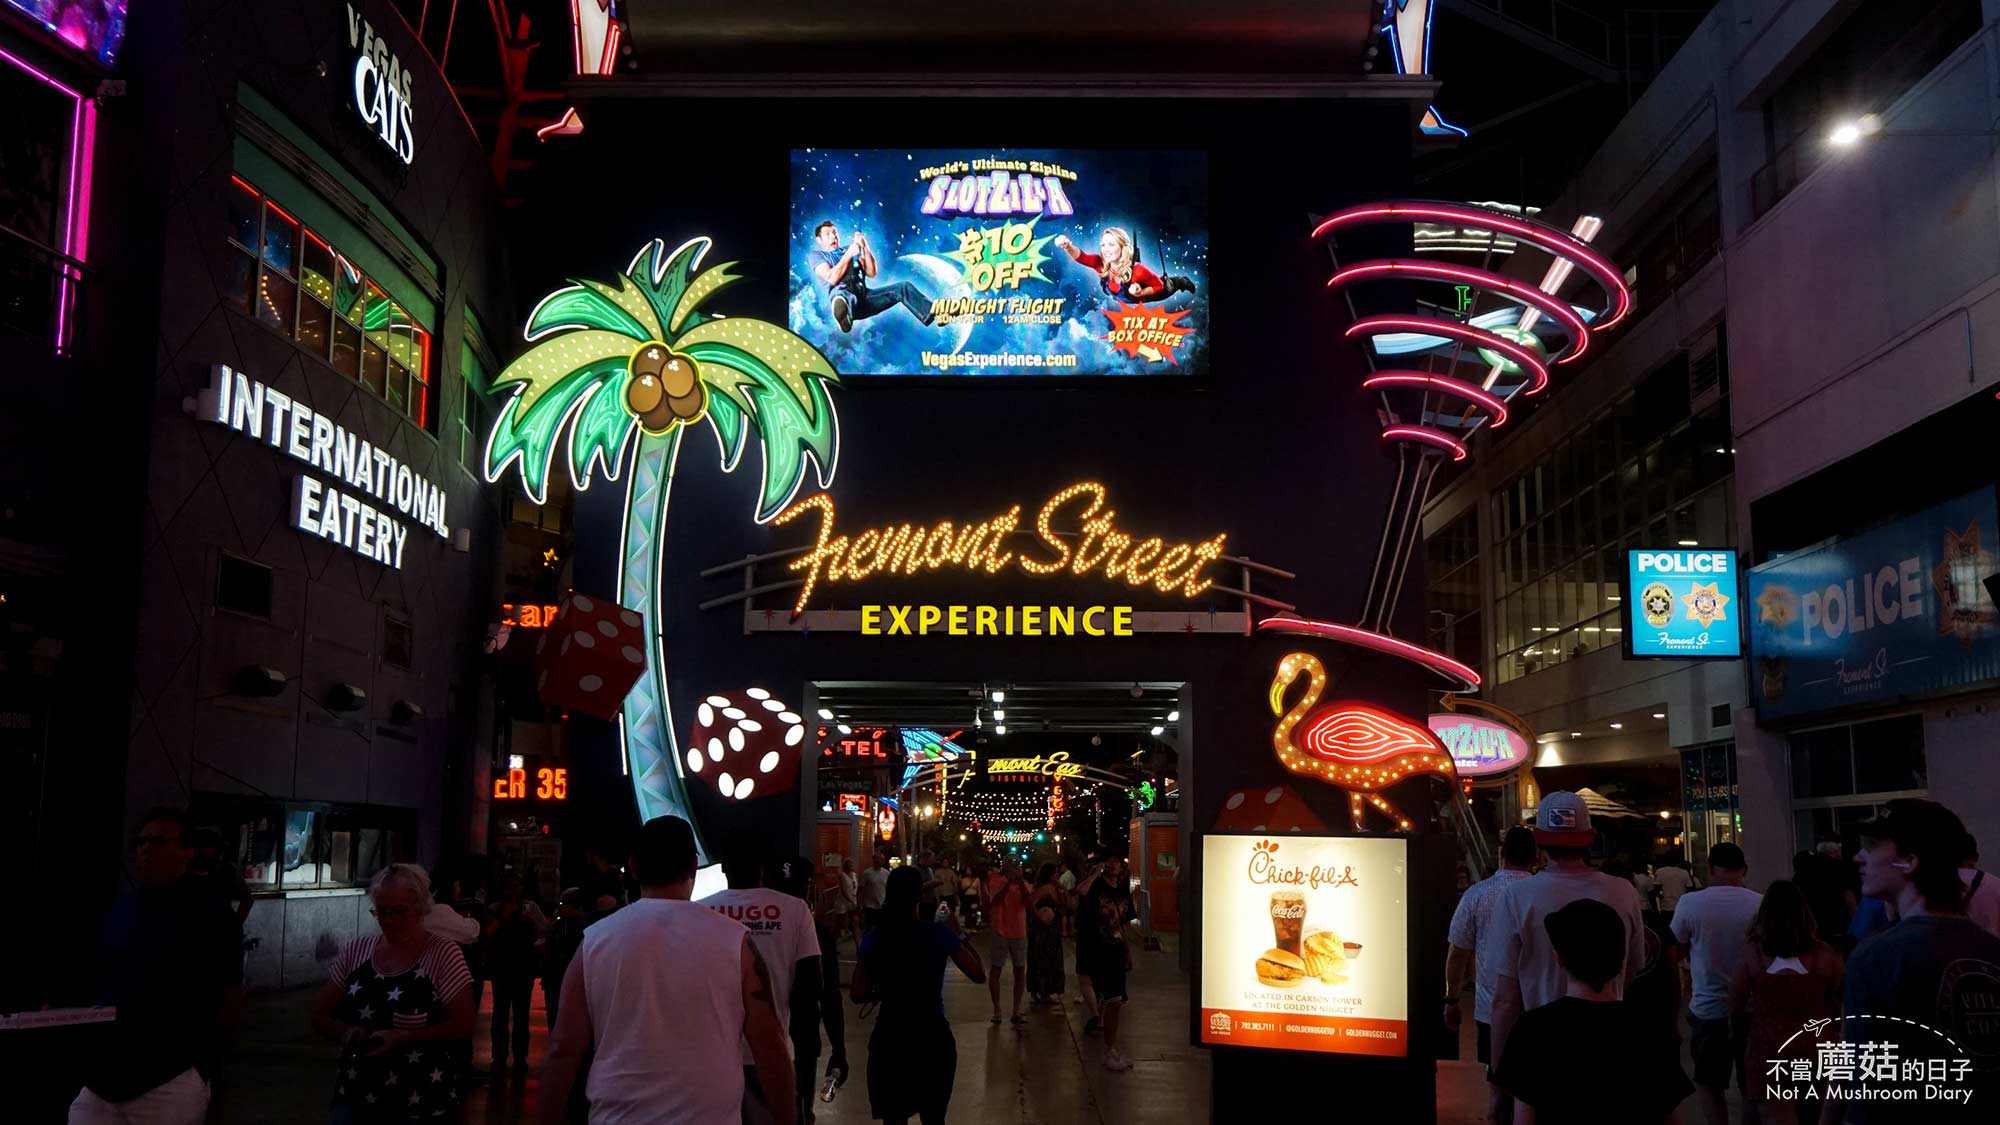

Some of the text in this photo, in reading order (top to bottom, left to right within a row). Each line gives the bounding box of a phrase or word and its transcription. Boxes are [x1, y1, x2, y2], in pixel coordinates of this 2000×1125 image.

[346, 2, 412, 107] VEGAS
[355, 55, 414, 165] CATS
[920, 159, 1078, 181] World's Ultimate Zipline
[959, 223, 1033, 264] $10
[971, 261, 1033, 292] OFF
[930, 298, 1065, 315] MIDNIGHT FLIGHT
[1107, 329, 1184, 347] BOX OFFICE
[1122, 316, 1169, 330] TIX AT
[921, 351, 1077, 370] VegasExperience.com
[217, 364, 450, 539] INTERNATIONAL
[299, 474, 408, 570] EATERY
[774, 480, 1228, 623] Fremont Street
[1637, 552, 1728, 573] POLICE
[1801, 556, 1922, 646] POLICE
[860, 604, 1134, 636] EXPERIENCE
[1657, 631, 1696, 646] Fremont
[537, 767, 567, 799] 35
[989, 775, 1046, 783] DISTRICT
[1248, 848, 1359, 890] Chick-fil-A
[1244, 992, 1281, 1001] LOCATED
[1295, 995, 1329, 1003] CARSON
[1331, 997, 1362, 1006] TOWER
[1265, 1002, 1281, 1010] THE
[1283, 1003, 1317, 1012] GOLDEN
[1320, 1005, 1354, 1015] NUGGET
